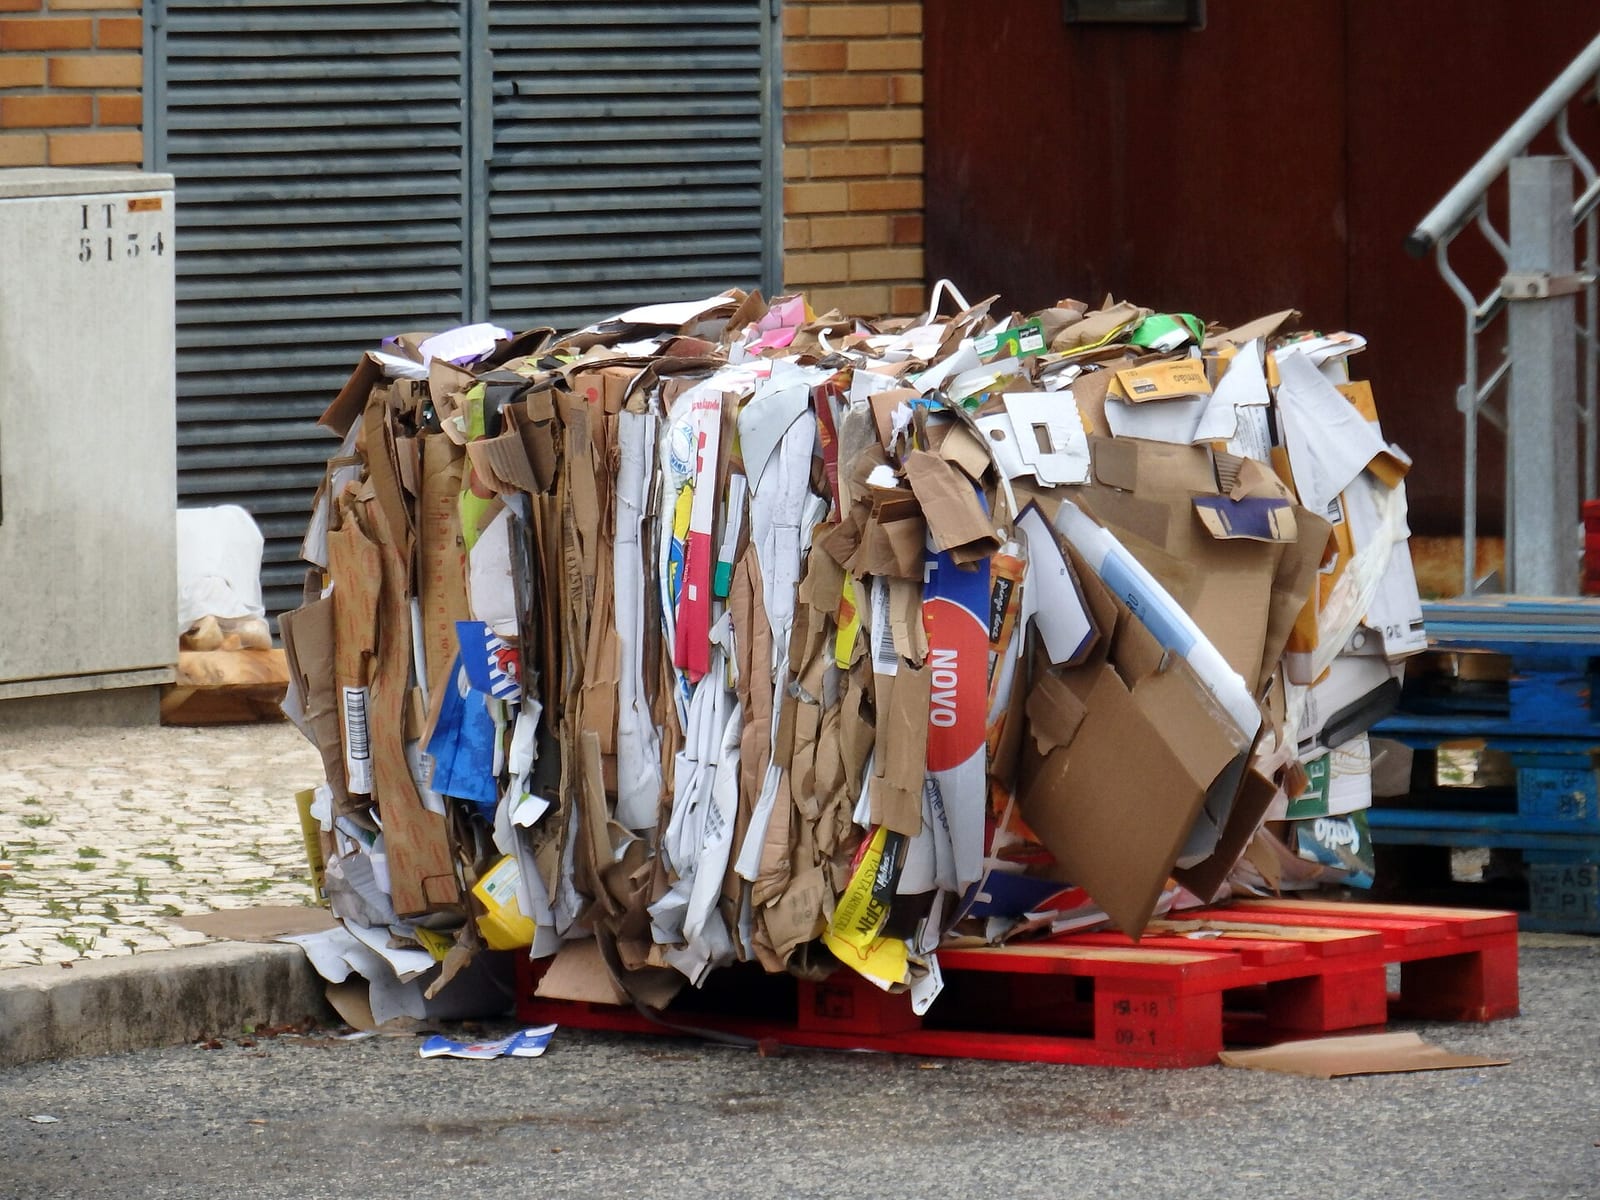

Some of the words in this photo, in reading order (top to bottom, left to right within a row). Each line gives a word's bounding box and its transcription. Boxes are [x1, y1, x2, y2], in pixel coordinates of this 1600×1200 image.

[992, 580, 1009, 611] pingo
[992, 613, 1004, 639] doce
[930, 649, 958, 728] NOVO
